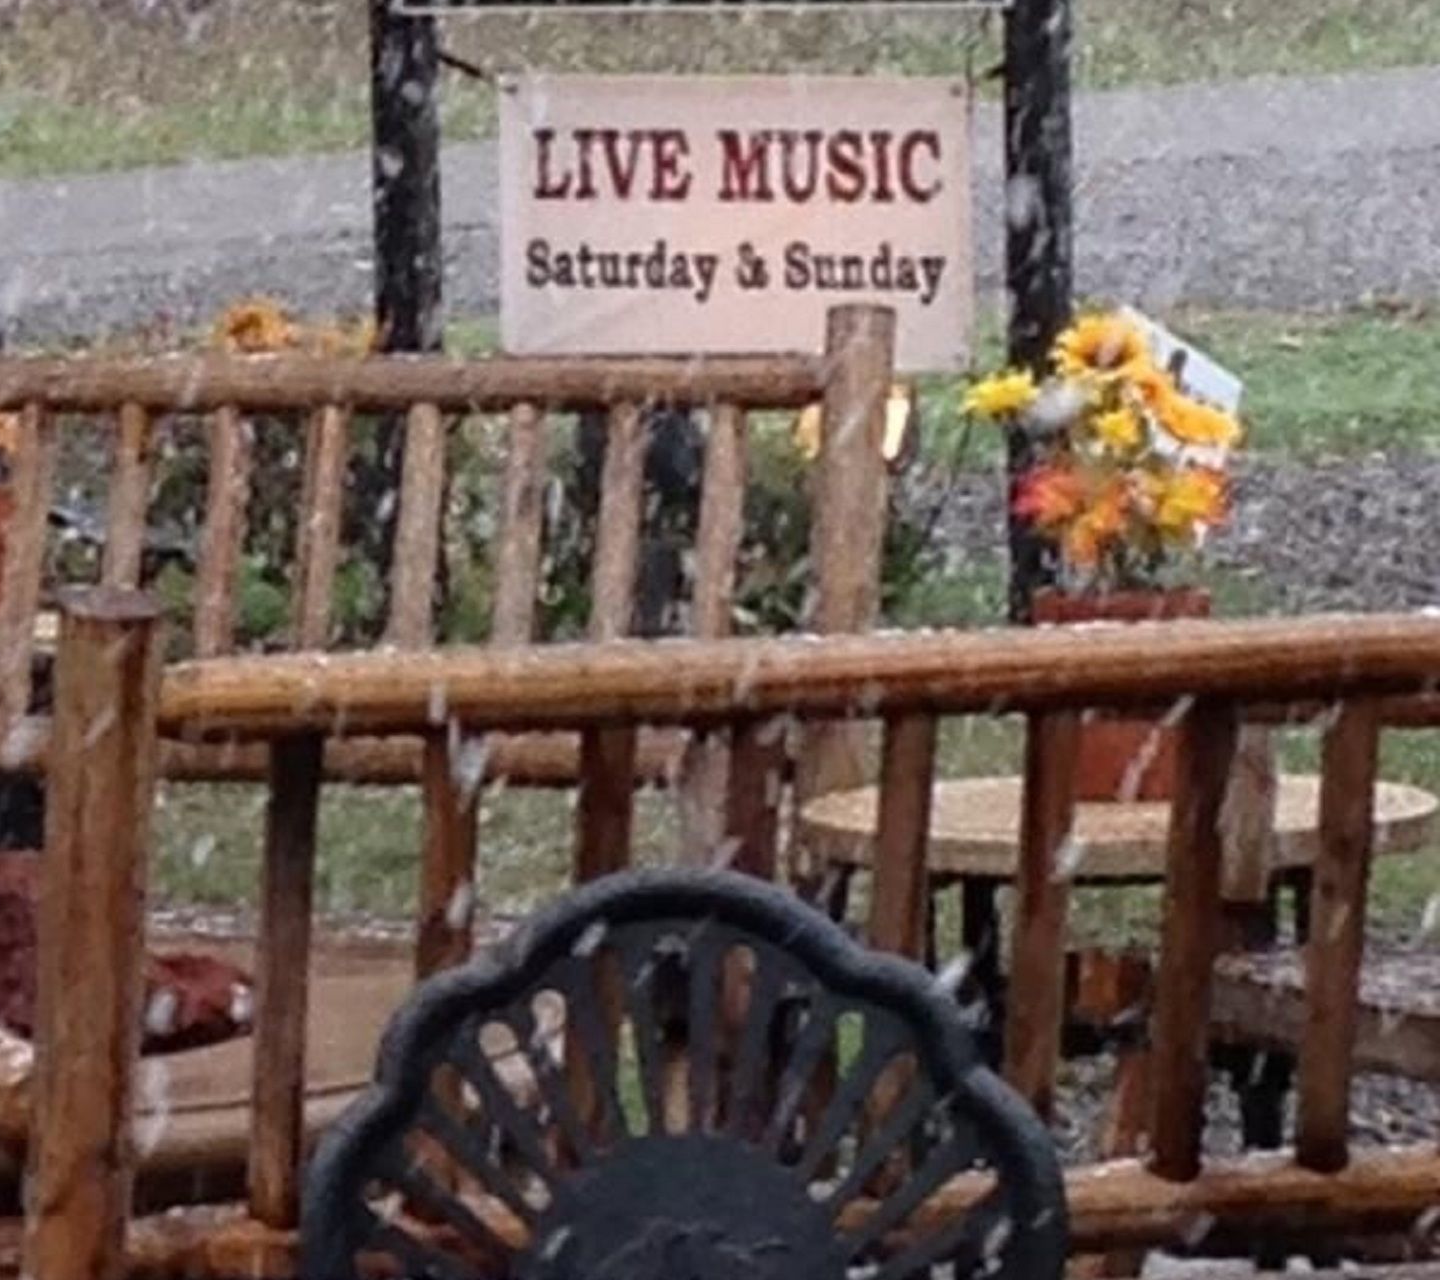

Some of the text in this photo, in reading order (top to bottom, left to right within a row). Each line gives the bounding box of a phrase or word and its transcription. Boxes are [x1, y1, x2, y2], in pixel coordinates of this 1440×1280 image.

[532, 128, 942, 203] LIVE MUSIC
[525, 238, 947, 305] Saturday & Sunday
